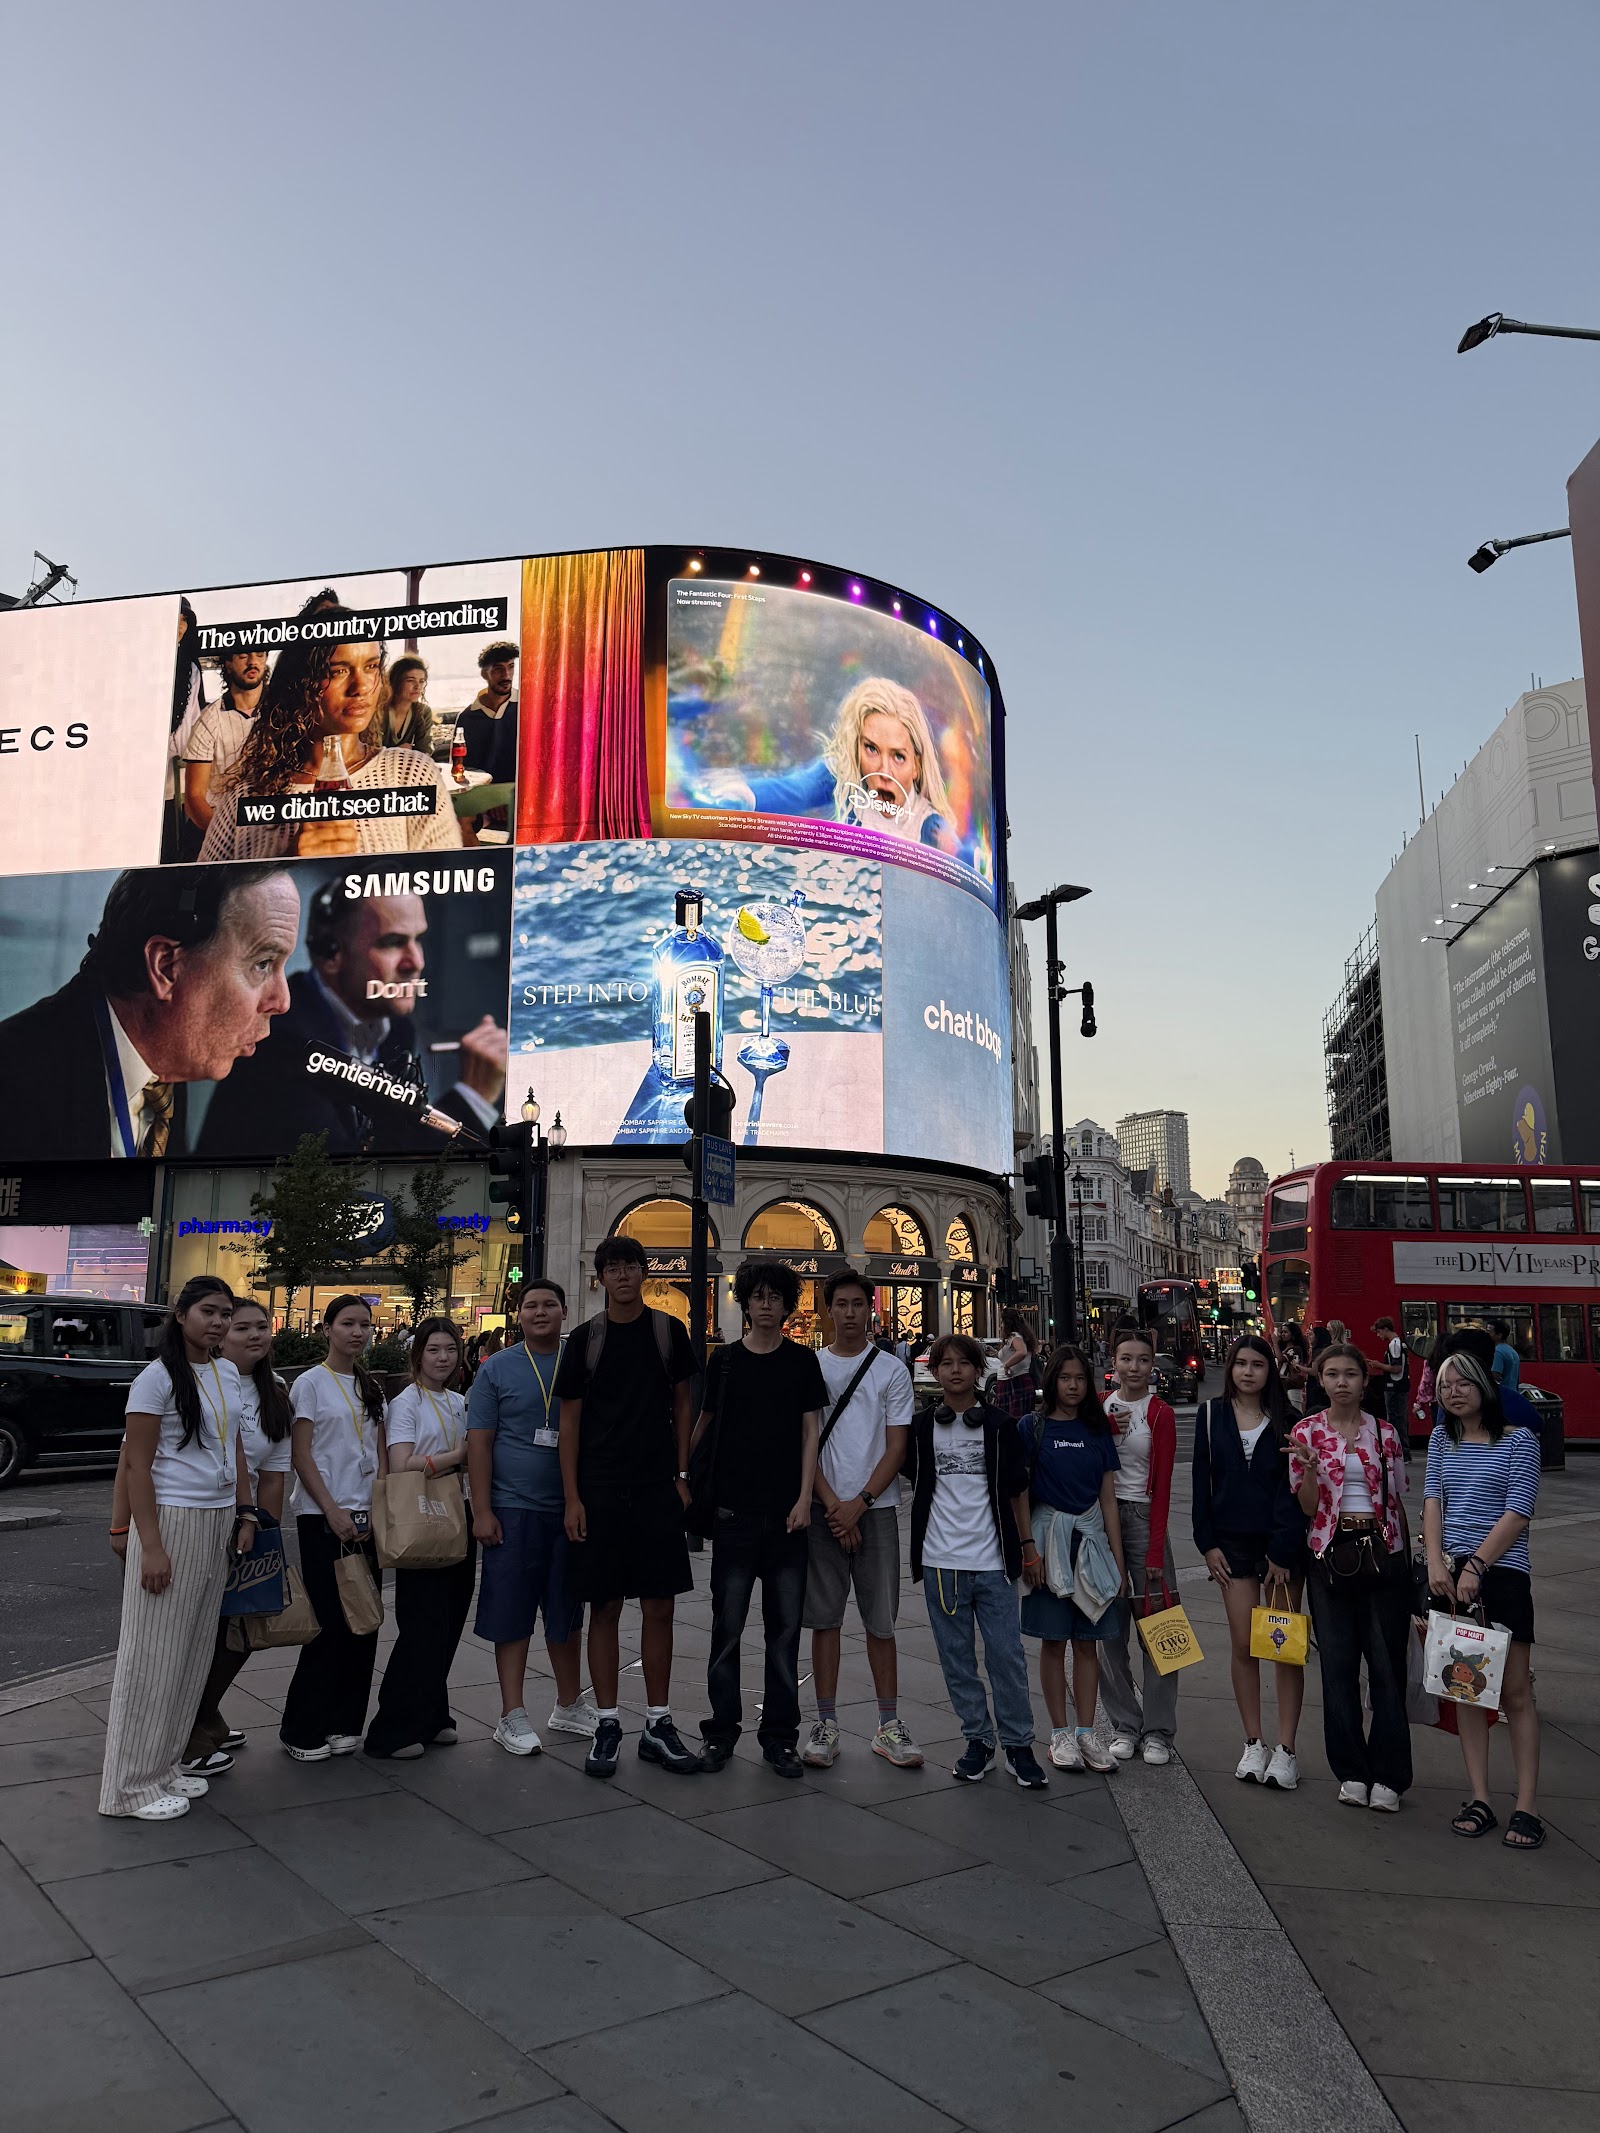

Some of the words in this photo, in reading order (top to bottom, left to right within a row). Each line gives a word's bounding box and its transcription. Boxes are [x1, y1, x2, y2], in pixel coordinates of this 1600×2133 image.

[689, 590, 717, 598] Fantastic
[692, 599, 722, 608] streaming
[198, 626, 236, 651] The
[239, 616, 299, 645] whole
[301, 612, 382, 644] country
[384, 602, 499, 637] pretending
[0, 722, 89, 754] ECS
[244, 804, 275, 823] we
[281, 792, 341, 821] didn't
[343, 798, 380, 818] see
[382, 790, 430, 815] that:
[844, 782, 915, 824] Disney+
[728, 816, 746, 824] joining
[788, 820, 798, 828] Sky
[798, 822, 818, 830] Ultimate
[344, 867, 496, 899] SAMSUNG
[1464, 957, 1492, 991] instrument
[1490, 949, 1502, 970] (the
[1501, 926, 1531, 960] telescreen,
[366, 977, 428, 1000] Don't
[681, 975, 712, 988] BOMBAY
[1460, 998, 1471, 1012] was
[1470, 983, 1486, 1008] called)
[1486, 970, 1500, 997] could
[1500, 965, 1508, 981] be
[1507, 945, 1532, 976] dimmed,
[522, 985, 581, 1006] STEP
[588, 981, 648, 1003] INTO
[778, 986, 822, 1009] THE
[828, 991, 879, 1017] BLUE
[1458, 1017, 1466, 1034] but
[1466, 1010, 1479, 1030] there
[1478, 1004, 1489, 1019] was
[1488, 1000, 1496, 1012] no
[1496, 993, 1506, 1010] way
[1506, 982, 1513, 998] of
[1512, 967, 1536, 995] shutting
[923, 999, 974, 1042] chat
[1464, 1033, 1472, 1051] off
[306, 1050, 417, 1106] gentlemen
[1462, 1067, 1478, 1087] George
[1478, 1054, 1497, 1078] Orwell,
[1463, 1084, 1486, 1107] Nineteen
[1485, 1066, 1519, 1096] Eighty-Four.
[750, 1129, 790, 1137] TRADEMARKS
[706, 1139, 718, 1151] BUS
[718, 1143, 732, 1155] LANE
[704, 1175, 719, 1187] LOOK
[720, 1178, 734, 1190] BOTH
[178, 1217, 273, 1237] pharmacy
[437, 1212, 492, 1232] eauty
[888, 1262, 914, 1277] Lindt
[1435, 1256, 1458, 1267] THE
[1458, 1246, 1541, 1274] DEVIL
[1534, 1259, 1573, 1269] WEARS
[1167, 1317, 1176, 1325] 38
[224, 1548, 283, 1592] Boots
[1158, 1633, 1187, 1652] TWG
[1456, 1628, 1468, 1637] POP
[1468, 1630, 1483, 1640] MART
[1168, 1646, 1182, 1654] TEA
